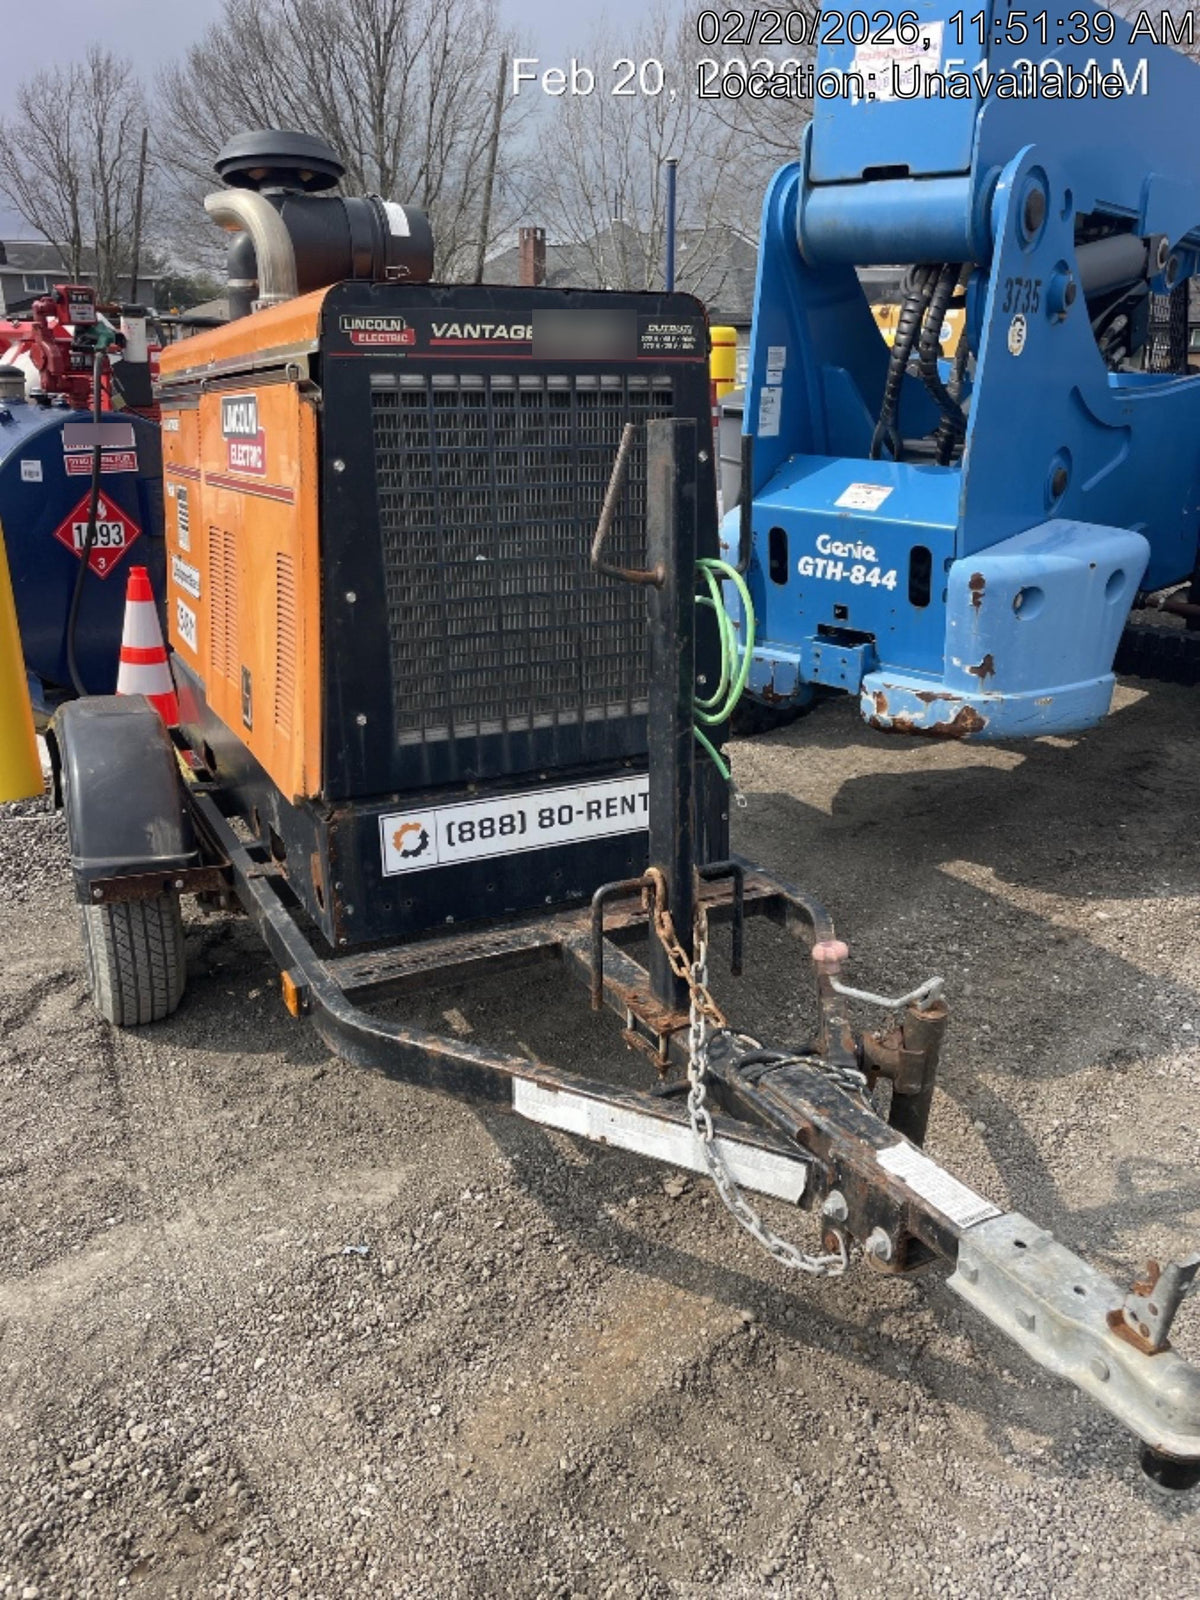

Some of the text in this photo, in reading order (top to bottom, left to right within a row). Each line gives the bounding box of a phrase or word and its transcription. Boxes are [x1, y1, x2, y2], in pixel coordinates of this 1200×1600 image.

[1002, 277, 1042, 314] 3735
[343, 318, 402, 332] LINCOLN
[358, 332, 409, 343] ELECTRIC
[223, 403, 257, 435] LINCOLN
[230, 443, 262, 469] ELECTRIC
[74, 523, 123, 547] 193
[815, 533, 877, 563] Genie
[98, 557, 107, 570] 3
[797, 555, 898, 592] GTH-844
[447, 809, 527, 847] (888)
